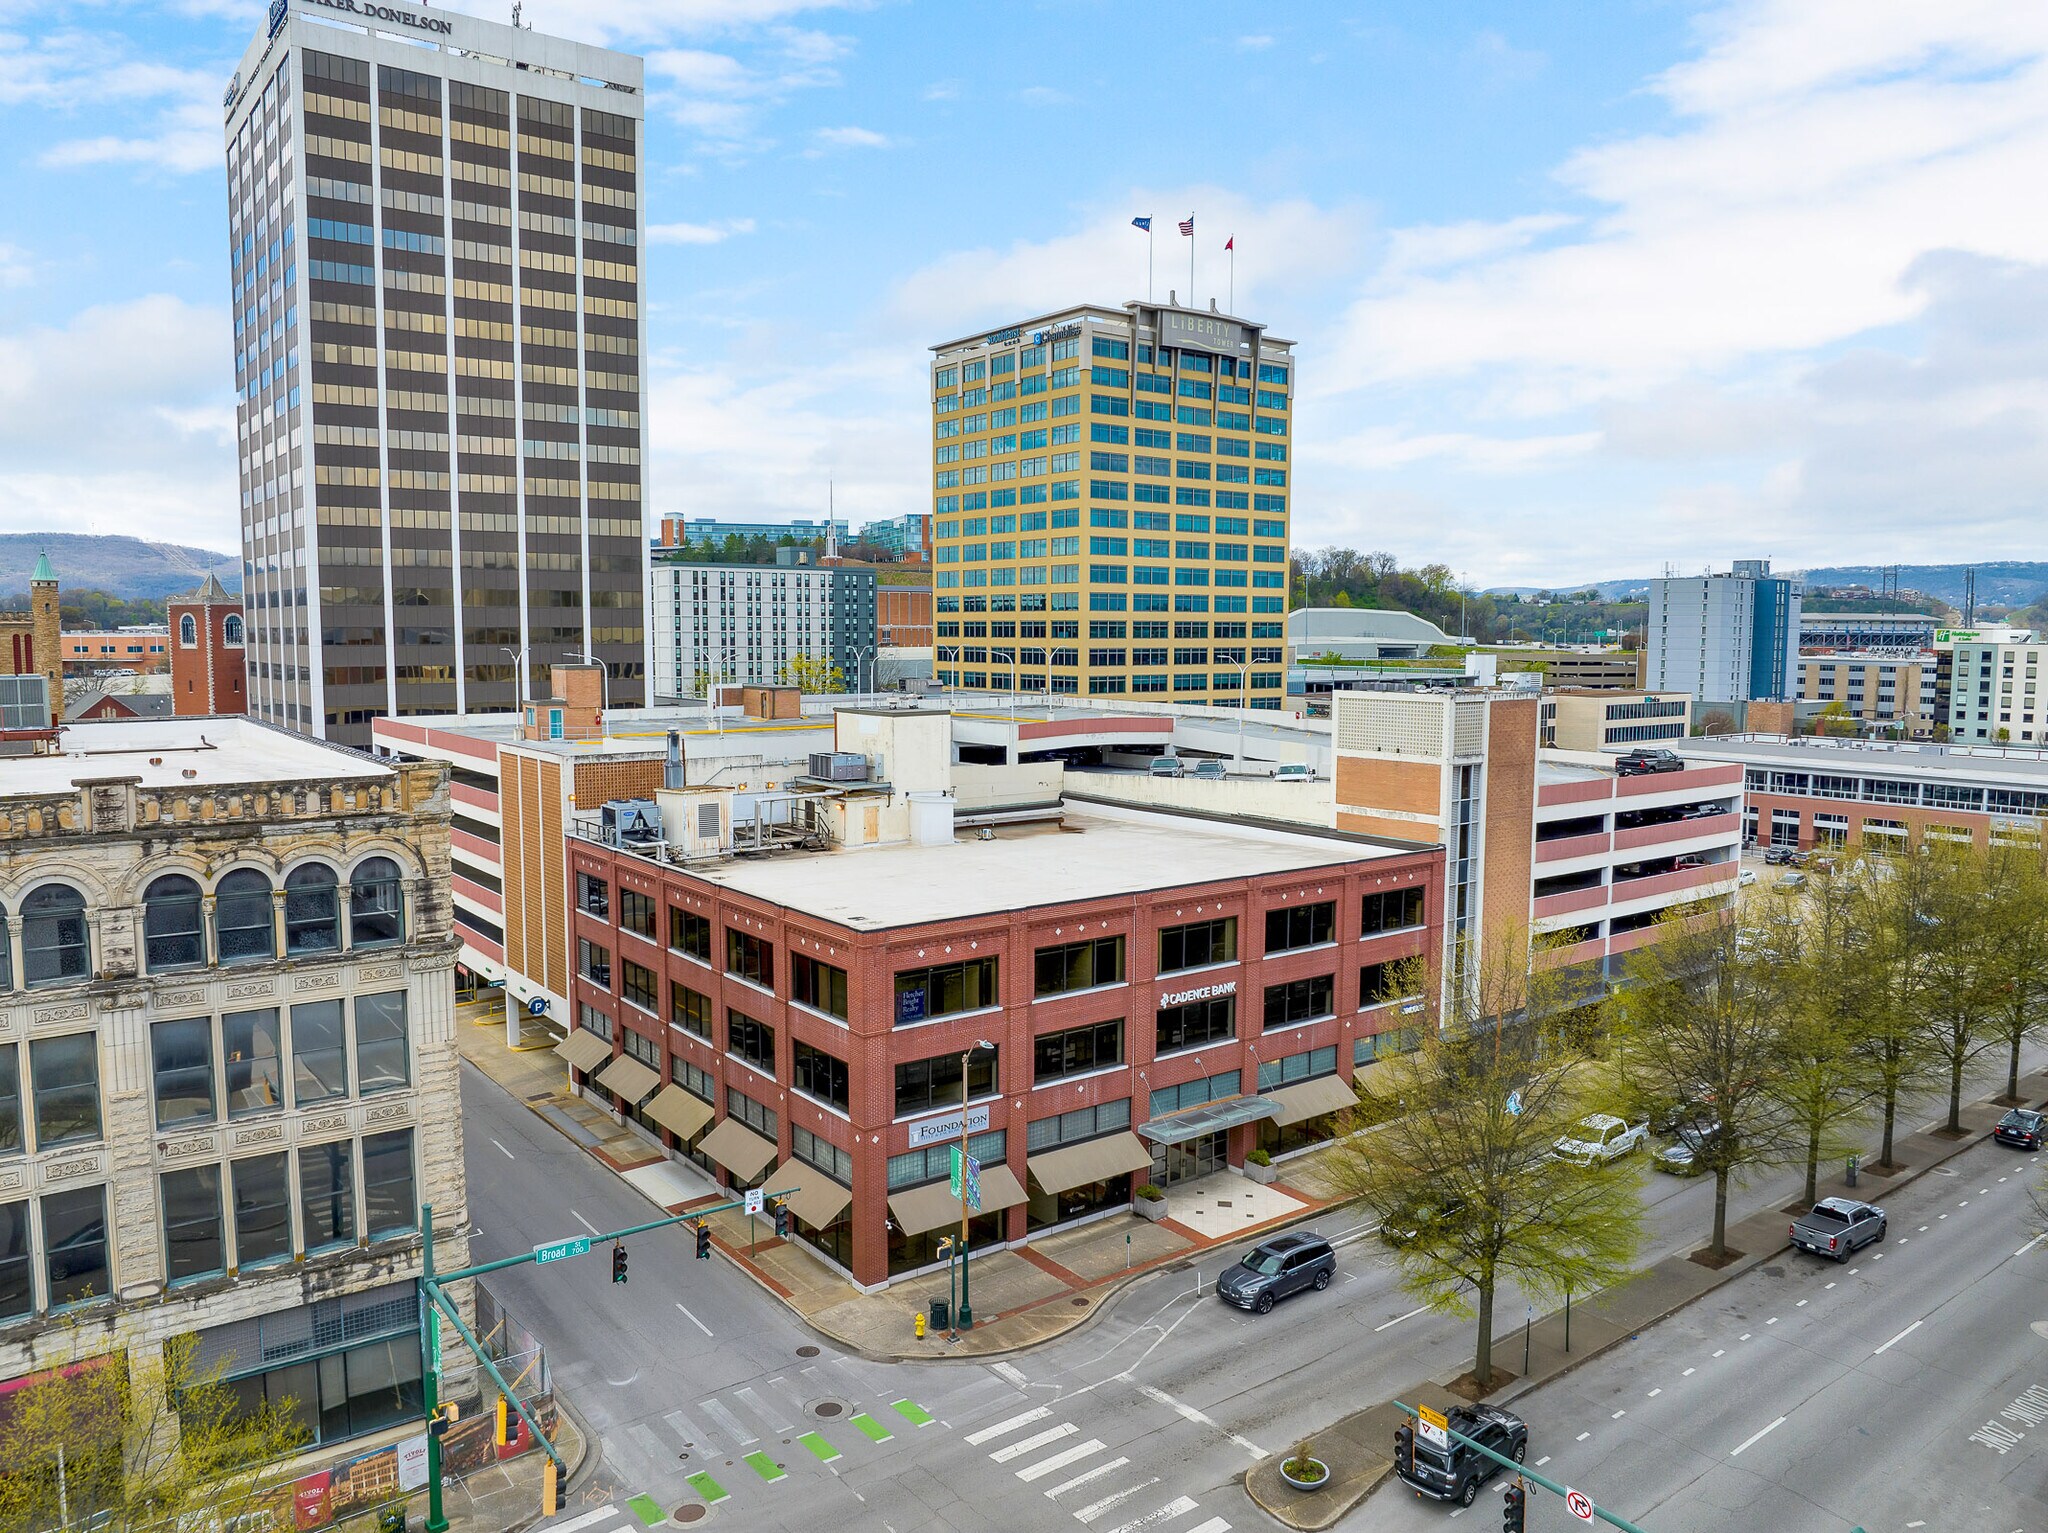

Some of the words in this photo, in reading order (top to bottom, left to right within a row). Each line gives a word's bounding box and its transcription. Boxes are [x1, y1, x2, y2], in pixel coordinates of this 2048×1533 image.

[364, 2, 452, 35] DONELSON
[1213, 337, 1234, 349] TOWER
[1169, 986, 1211, 1005] CADENCE
[1211, 981, 1237, 996] BANK
[541, 1245, 566, 1261] Broad
[572, 1246, 584, 1254] 700
[1968, 1419, 2026, 1455] ZONE
[404, 1448, 426, 1459] TIVOLI
[299, 1487, 324, 1498] TIVOLI
